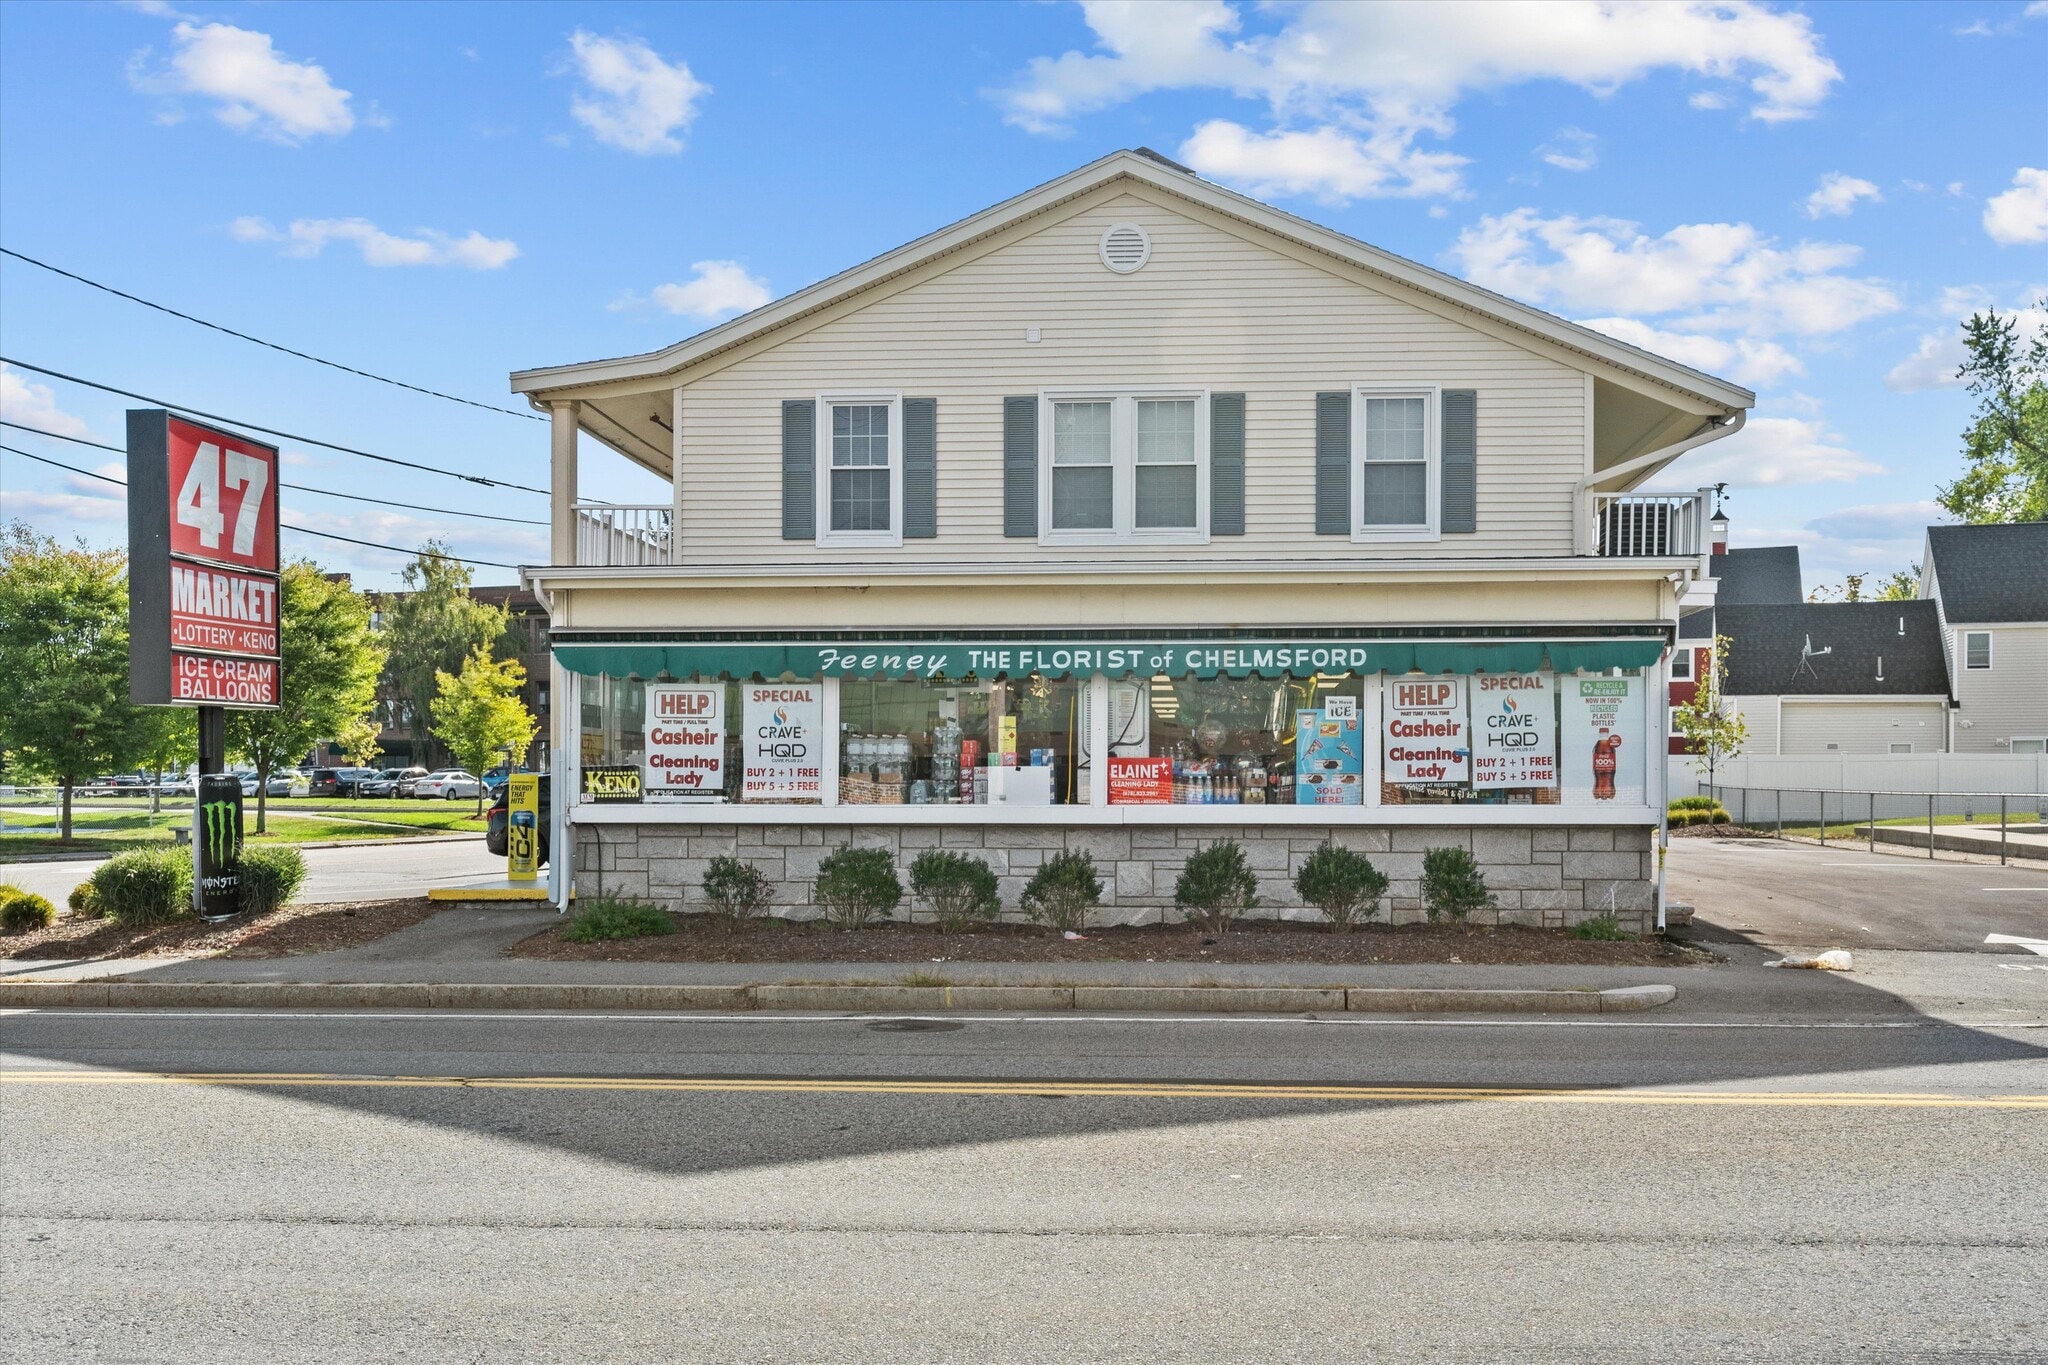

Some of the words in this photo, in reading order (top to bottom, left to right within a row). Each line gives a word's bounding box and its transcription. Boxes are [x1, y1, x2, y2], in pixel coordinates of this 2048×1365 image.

[177, 441, 268, 556] 47
[172, 567, 275, 624] MARKET
[178, 625, 235, 646] LOTTERY
[243, 632, 275, 650] KENO
[179, 656, 207, 678] ICE
[213, 659, 271, 683] CREAM
[818, 649, 947, 677] Feeney
[969, 650, 1010, 669] THE
[1019, 650, 1144, 669] FLORIST
[1151, 649, 1173, 668] of
[1186, 649, 1367, 668] CHELMSFORD
[180, 677, 271, 703] BALLOONS
[1480, 676, 1544, 691] SPECIAL
[753, 690, 813, 702] SPECIAL
[1399, 685, 1450, 706] HELP
[660, 694, 709, 714] HELP
[1330, 706, 1352, 717] ICE
[651, 727, 718, 745] Casheir
[1390, 719, 1461, 737] Casheir
[1488, 732, 1538, 747] HQD
[759, 744, 807, 757] HQD
[1389, 747, 1463, 763] Cleaning
[649, 754, 719, 771] Cleaning
[1476, 758, 1497, 767] BUY
[1500, 758, 1506, 767] 2
[1509, 759, 1516, 767] +
[1521, 757, 1525, 766] 1
[1529, 756, 1552, 766] FREE
[666, 771, 703, 787] Lady
[747, 768, 766, 777] BUY
[769, 768, 775, 777] 2
[779, 769, 785, 777] +
[789, 768, 793, 777] 1
[797, 768, 819, 777] FREE
[1110, 764, 1159, 778] ELAINE
[1407, 763, 1446, 780] Lady
[1477, 772, 1497, 781] BUY
[1500, 772, 1506, 781] 5
[1520, 771, 1527, 780] 5
[1530, 770, 1553, 780] FREE
[511, 784, 533, 792] ENERGY
[585, 771, 640, 793] KENO
[747, 782, 766, 790] BUY
[769, 782, 775, 790] 5
[788, 782, 794, 790] 5
[797, 782, 819, 790] FREE
[1316, 787, 1343, 795] SOLD
[1314, 796, 1344, 804] HERE!
[516, 820, 531, 858] C4
